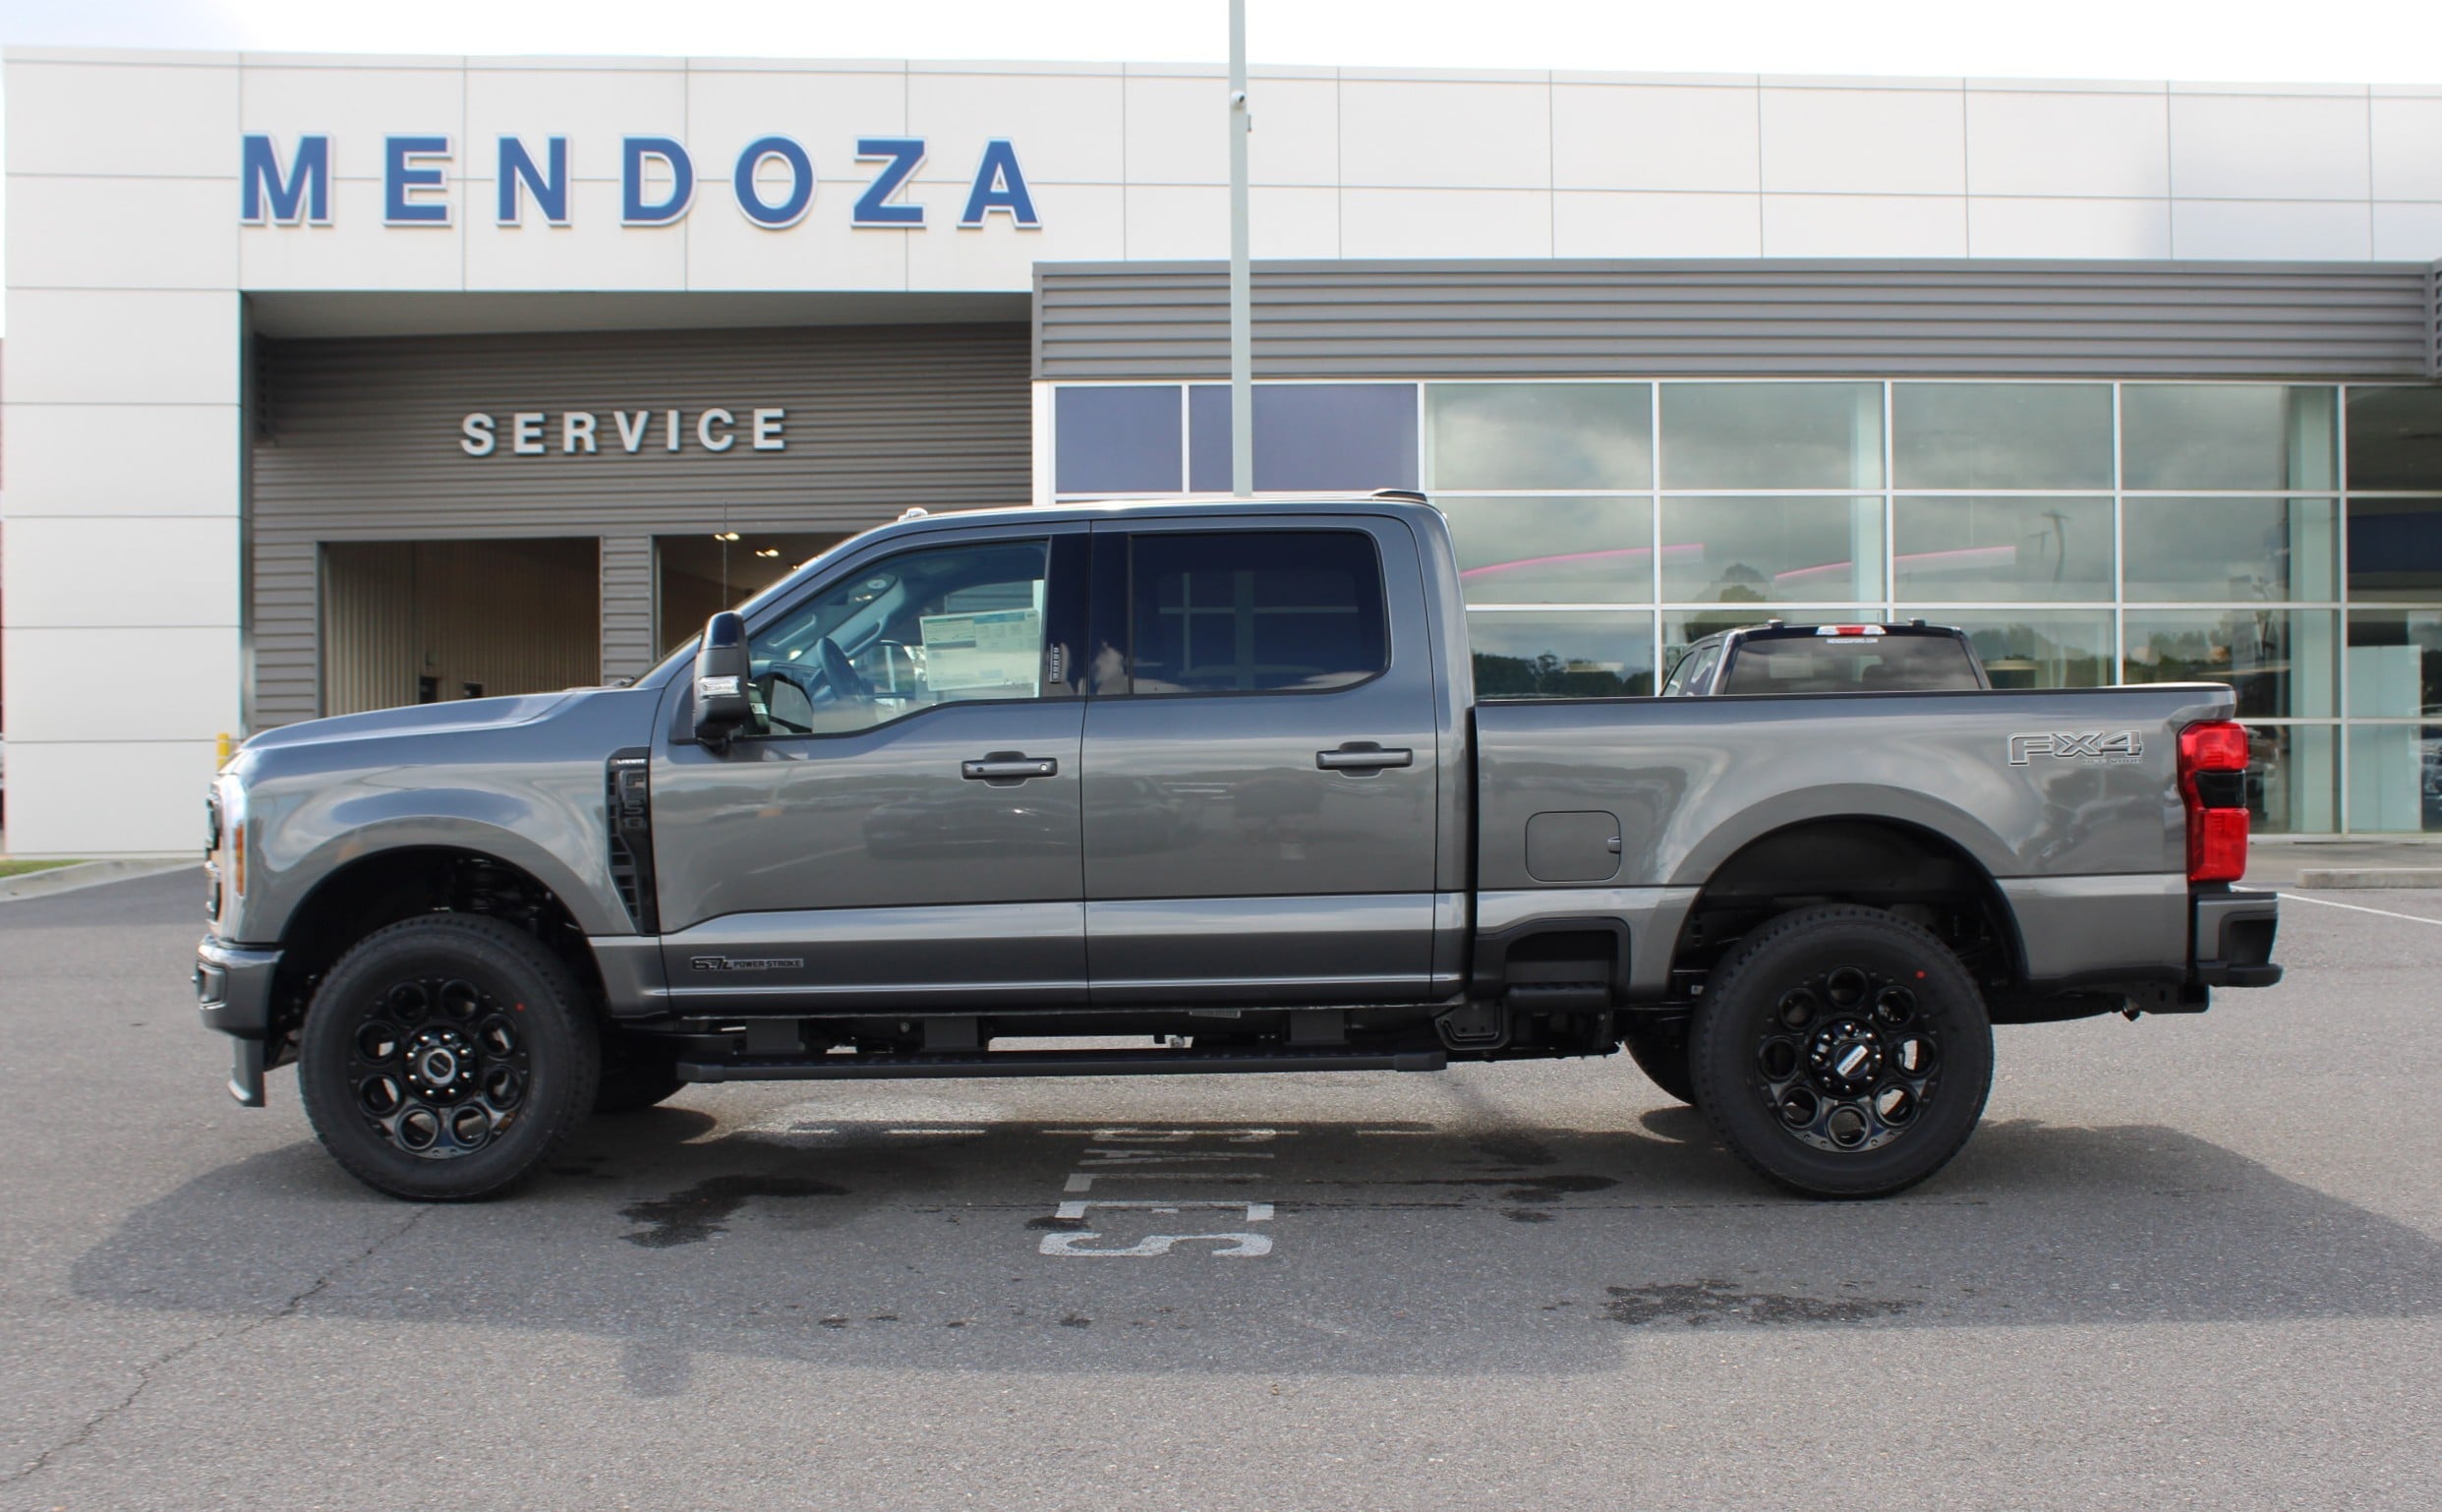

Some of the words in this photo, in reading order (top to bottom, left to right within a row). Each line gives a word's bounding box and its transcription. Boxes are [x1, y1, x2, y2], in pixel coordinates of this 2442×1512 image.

[241, 134, 1041, 230] MENDOZA
[459, 408, 788, 457] SERVICE
[2007, 730, 2143, 767] FX4
[767, 959, 803, 967] STROKE
